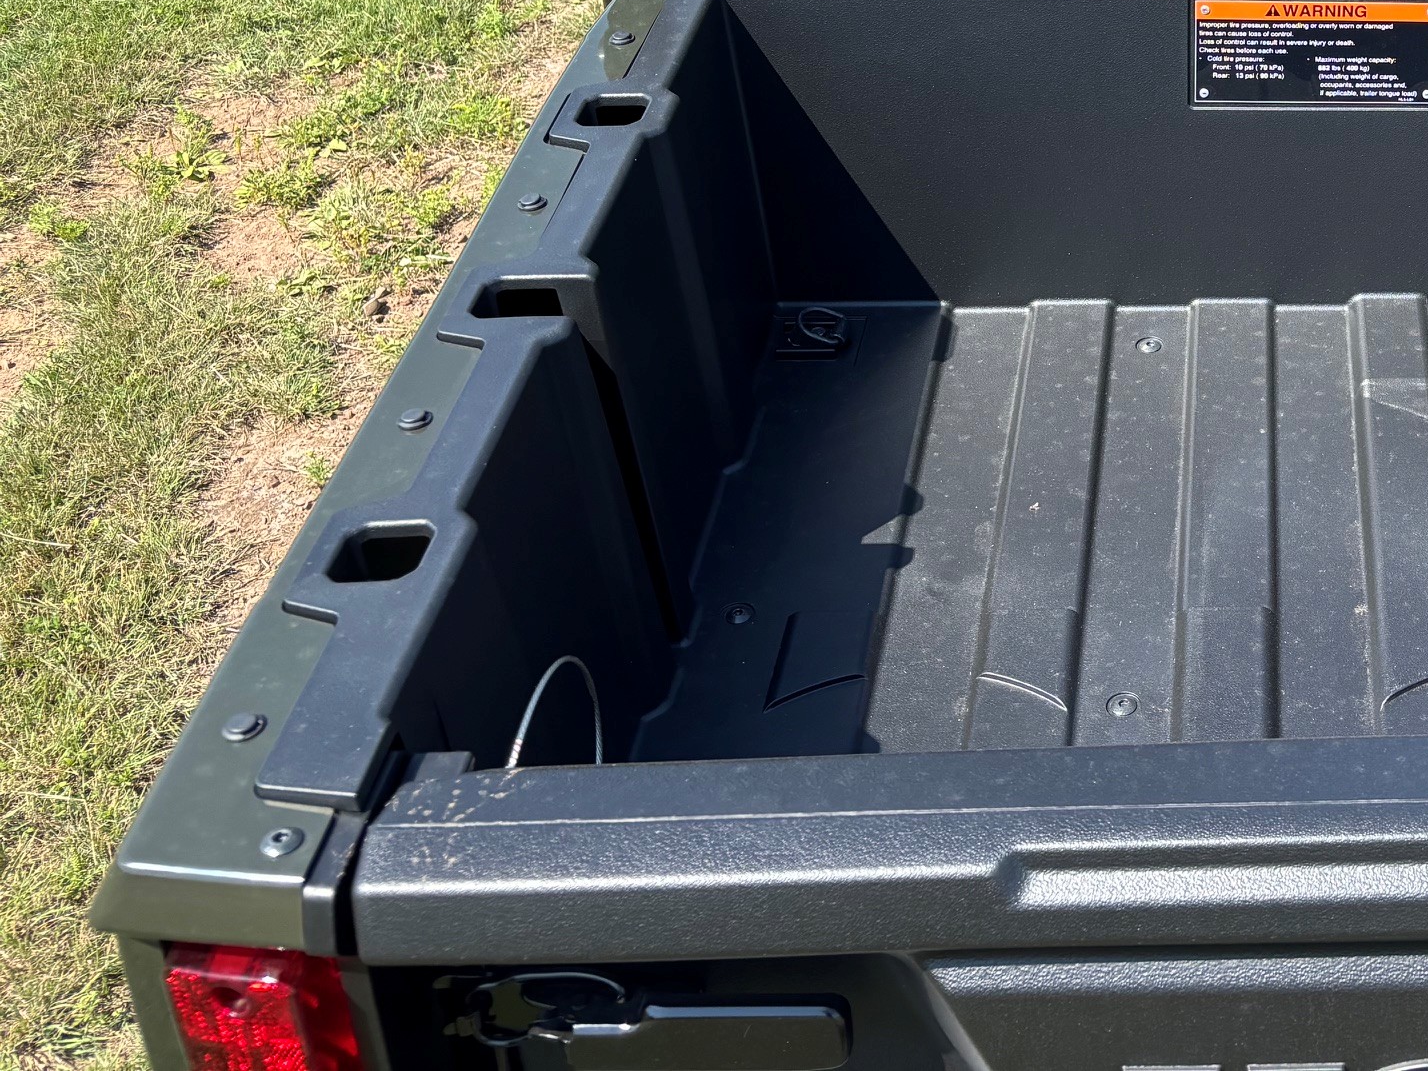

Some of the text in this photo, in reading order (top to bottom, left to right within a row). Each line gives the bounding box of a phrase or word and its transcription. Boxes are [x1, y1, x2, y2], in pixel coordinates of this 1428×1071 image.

[1283, 5, 1367, 17] WARNING
[1273, 22, 1309, 30] overloading
[1364, 23, 1393, 31] damaged
[1235, 56, 1264, 64] pressure:
[1369, 57, 1396, 65] capacity:
[1245, 64, 1254, 72] psi
[1319, 73, 1349, 81] (including
[1320, 81, 1353, 89] occupants,
[1379, 90, 1400, 98] tongue
[1402, 90, 1417, 98] load)
